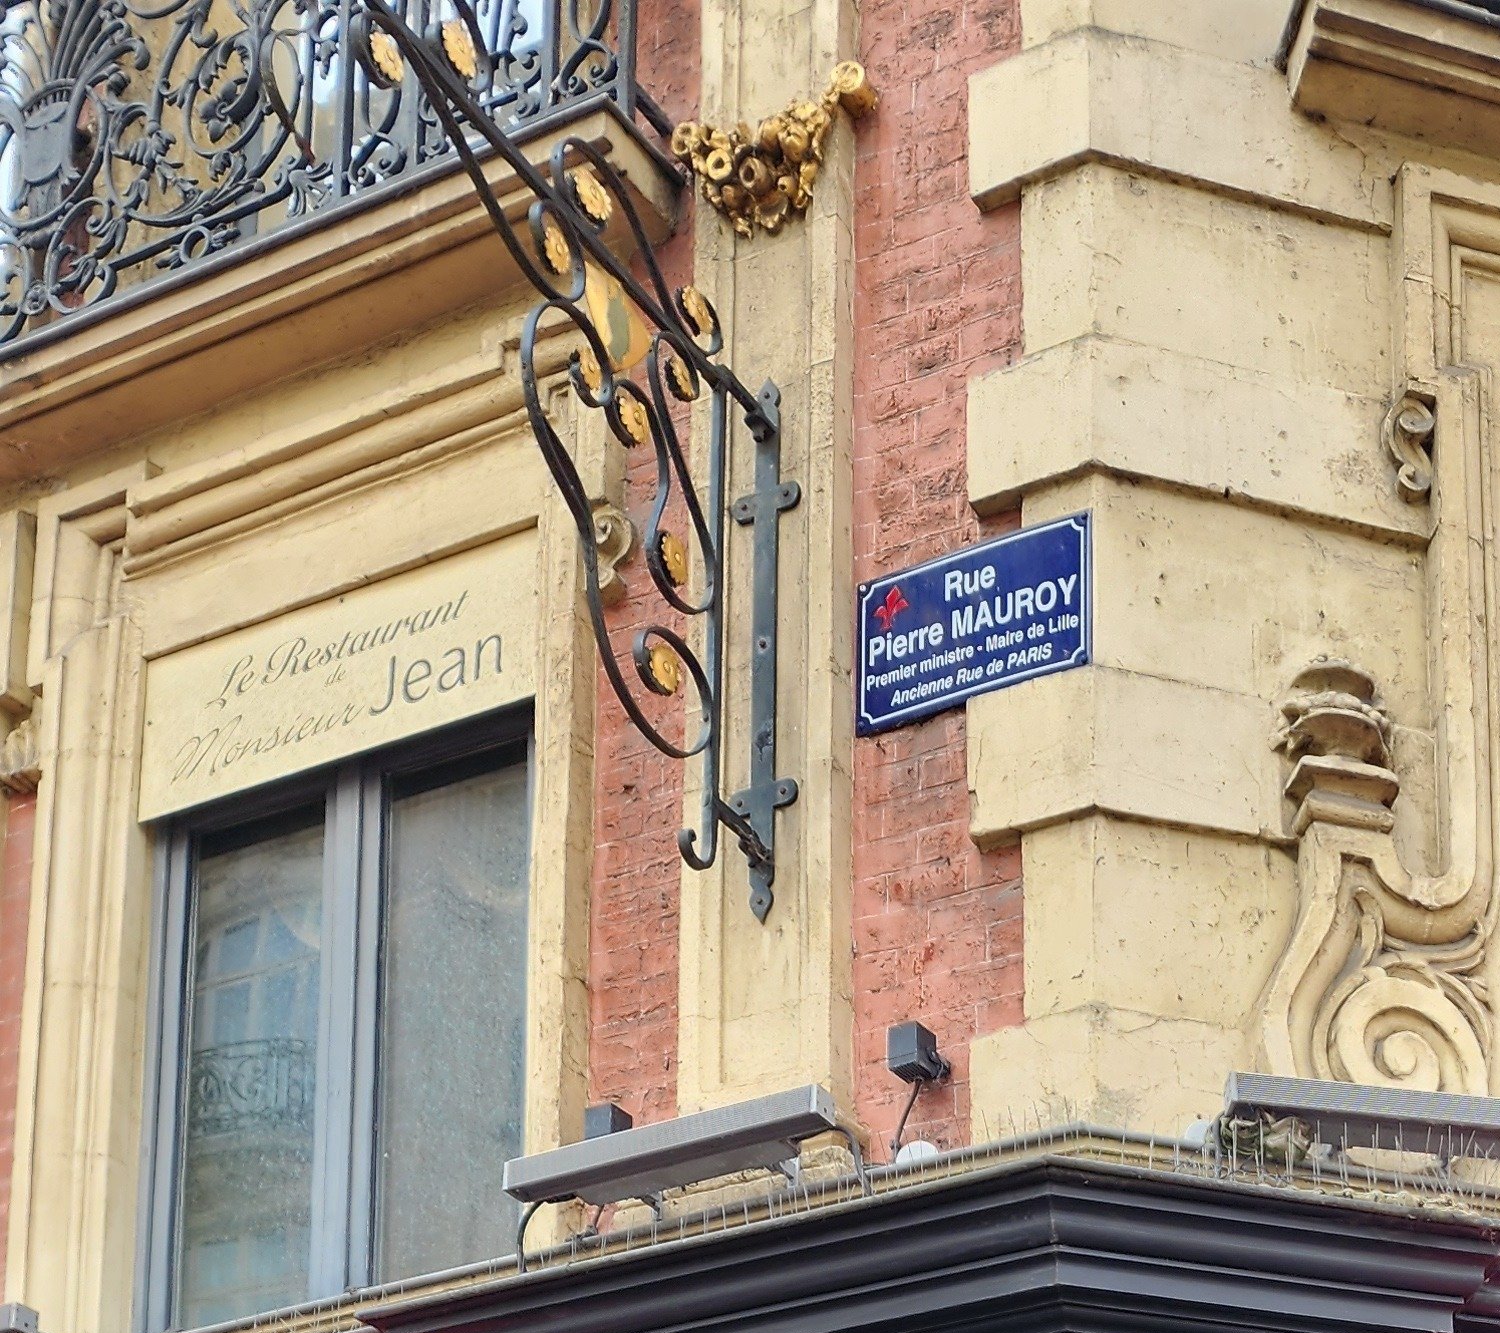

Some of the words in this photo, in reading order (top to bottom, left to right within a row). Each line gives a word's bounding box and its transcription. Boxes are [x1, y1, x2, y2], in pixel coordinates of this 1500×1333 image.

[868, 621, 943, 667] Pierre
[952, 574, 1078, 639] MAUROY
[944, 564, 996, 602] Rue
[205, 654, 263, 711] Le
[260, 589, 470, 684] Restaurant
[324, 663, 347, 688] de
[867, 662, 916, 691] Premier
[919, 645, 974, 673] ministre
[985, 630, 1024, 653] Maire
[1026, 620, 1045, 638] de
[1048, 612, 1079, 635] Lille
[890, 676, 953, 707] Ancienne
[956, 667, 983, 687] Rue
[986, 658, 1004, 675] de
[1007, 642, 1053, 671] PARIS
[170, 702, 364, 786] Monsieur
[368, 632, 504, 717] Jean
